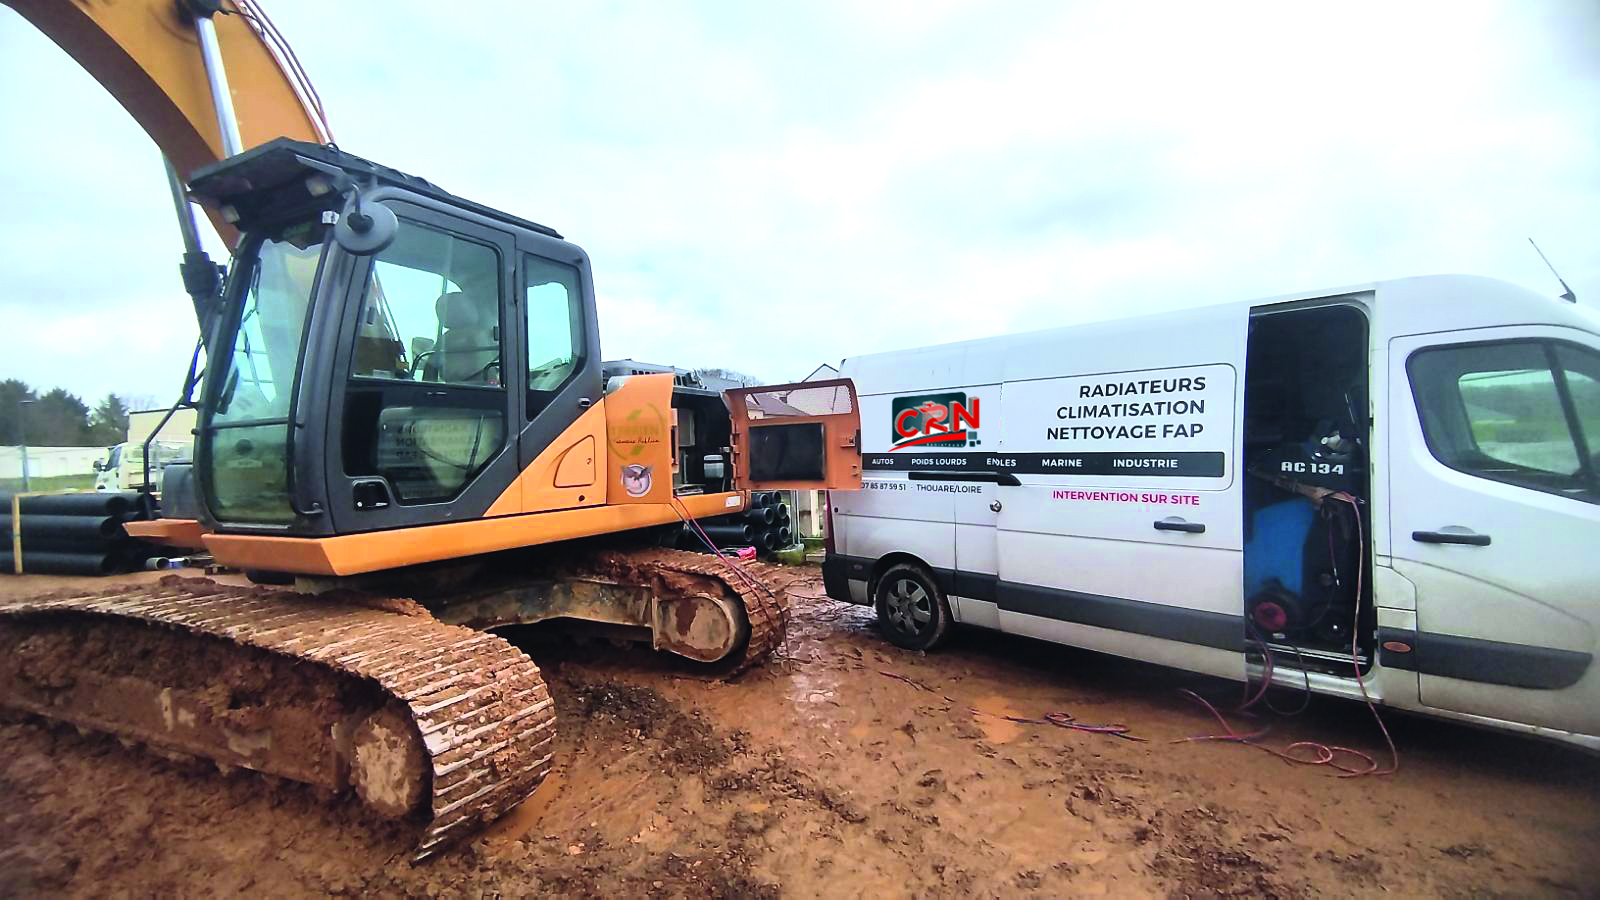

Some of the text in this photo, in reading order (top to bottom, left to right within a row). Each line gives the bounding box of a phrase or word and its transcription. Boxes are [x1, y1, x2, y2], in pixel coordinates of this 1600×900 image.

[1079, 376, 1206, 398] RADIATEURS
[894, 396, 980, 438] CRN
[1056, 400, 1205, 419] CLIMATISATION
[1047, 423, 1204, 440] NETTOYAGE FAP
[911, 458, 934, 466] POIDS
[935, 458, 967, 466] LOURDS
[1041, 458, 1083, 468] MARINE
[1113, 459, 1179, 468] INDUSTRIE
[1281, 461, 1344, 475] AC 134
[916, 484, 982, 493] THOUARE/LOIRE
[1053, 490, 1200, 505] INTERVENTION SUR SITE
